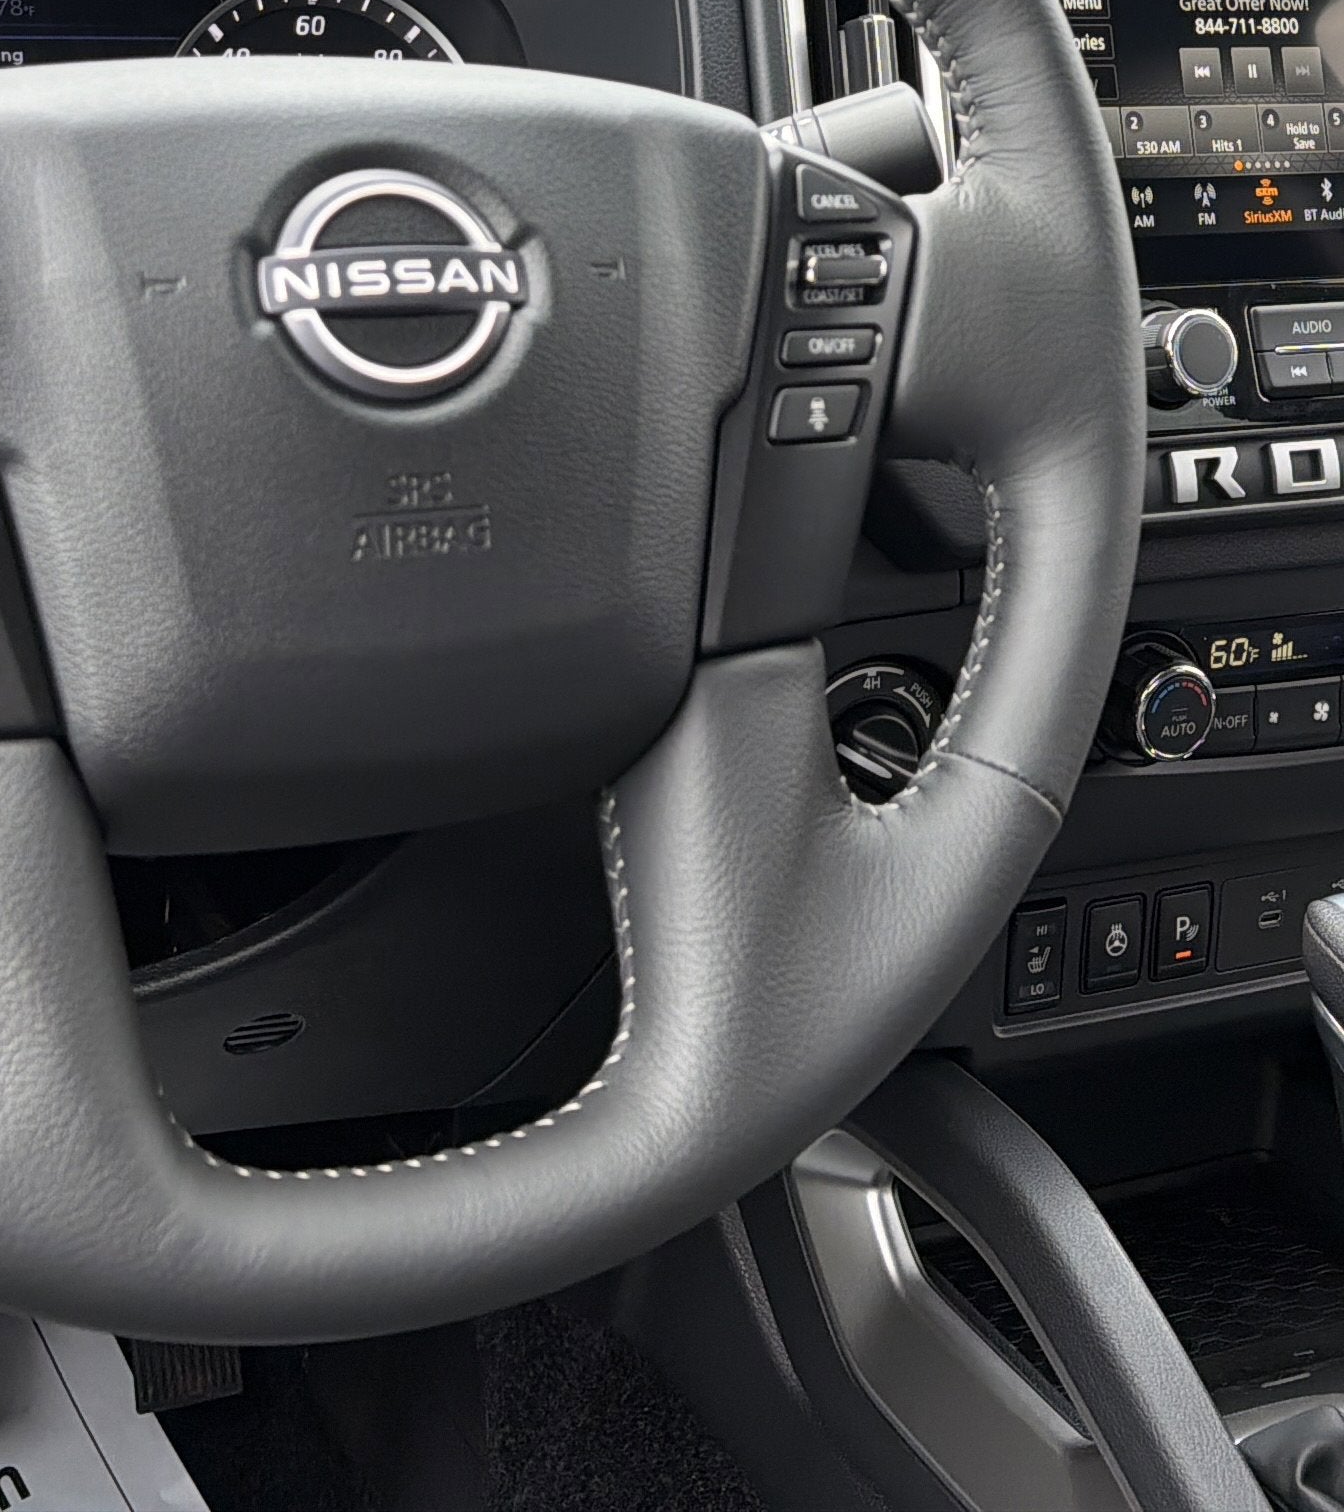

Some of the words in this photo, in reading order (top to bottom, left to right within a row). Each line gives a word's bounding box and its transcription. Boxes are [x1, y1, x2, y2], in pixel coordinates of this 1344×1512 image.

[295, 15, 326, 36] 60
[1195, 17, 1299, 35] 844-711-8800
[1129, 117, 1139, 130] 2
[1199, 115, 1207, 129] 3
[1266, 114, 1275, 127] 4
[1332, 113, 1341, 126] 5
[1286, 121, 1308, 135] Hold
[1309, 123, 1320, 135] to
[1136, 141, 1158, 155] 530
[1160, 140, 1181, 154] AM
[1211, 139, 1234, 152] Hits
[1236, 139, 1243, 151] 1
[1293, 138, 1316, 150] Save
[810, 194, 860, 209] CANCEL
[1134, 213, 1156, 229] AM
[1198, 212, 1217, 226] FM
[1244, 209, 1293, 225] SiriusXM
[1304, 208, 1318, 221] BT
[272, 258, 520, 303] NISSAN
[1292, 319, 1332, 335] AUDIO
[808, 338, 856, 354] ON/OFF
[1202, 395, 1236, 407] POWER
[1210, 637, 1260, 669] 60°F
[862, 676, 881, 690] 4H
[909, 681, 934, 709] PUSH
[1160, 721, 1197, 738] AUTO
[1036, 924, 1048, 937] HI
[1030, 983, 1045, 996] LO
